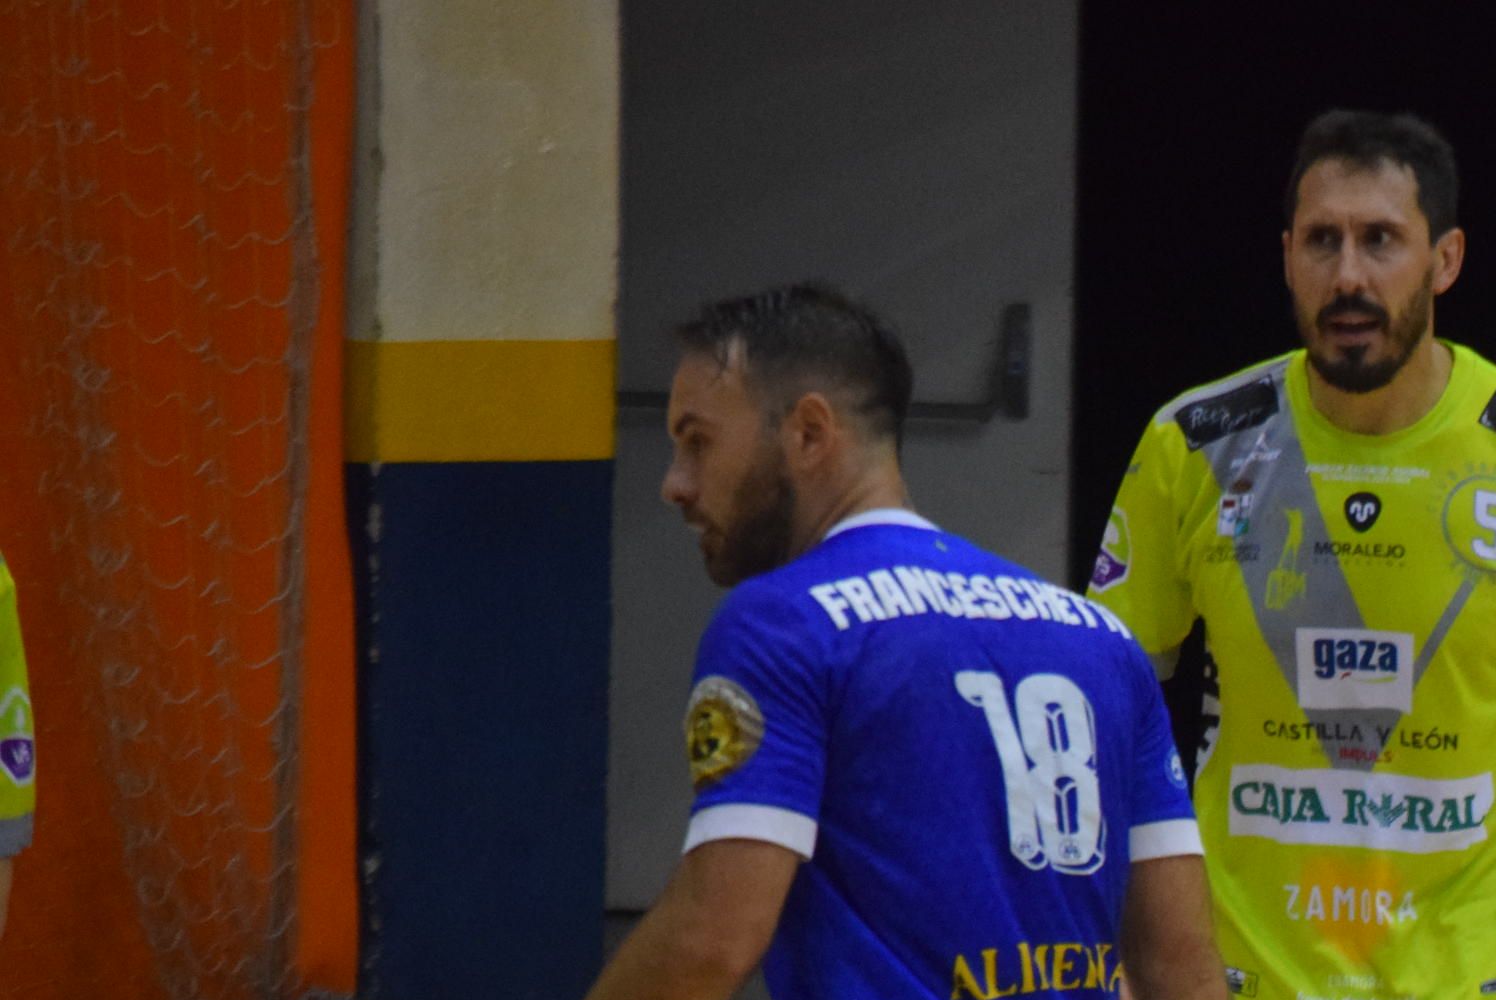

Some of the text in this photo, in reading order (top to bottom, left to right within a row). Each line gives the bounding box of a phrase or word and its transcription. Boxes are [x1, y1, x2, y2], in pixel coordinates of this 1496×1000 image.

[1313, 540, 1406, 560] MORALEJO
[1313, 637, 1398, 680] gaza
[1263, 719, 1460, 750] CASTILLA Y LEÓN
[954, 669, 1107, 876] 18
[1232, 782, 1331, 824] CAJA
[1282, 884, 1418, 925] ZAMORA
